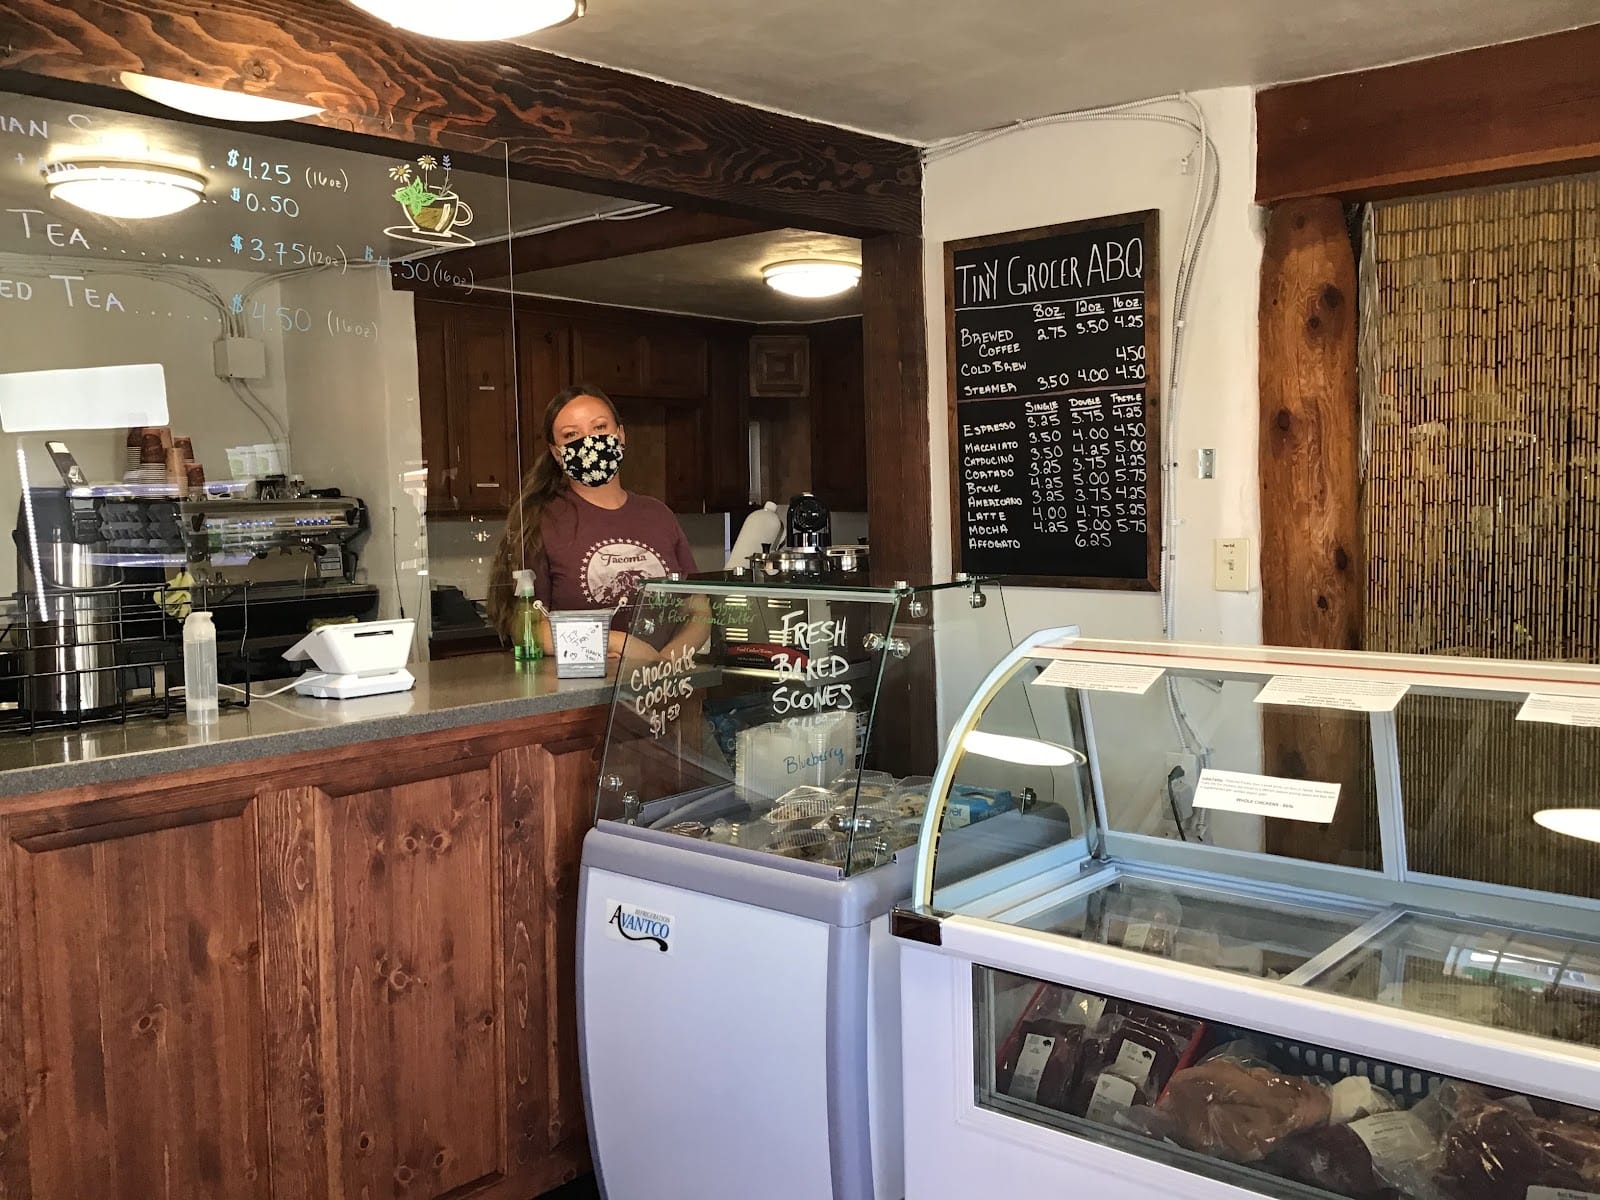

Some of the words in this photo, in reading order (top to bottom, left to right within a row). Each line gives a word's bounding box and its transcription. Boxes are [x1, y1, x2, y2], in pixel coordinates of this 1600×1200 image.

[226, 148, 292, 185] $4.25
[229, 186, 300, 219] $0.50
[6, 208, 91, 250] TEA
[955, 259, 998, 305] TINY
[1007, 255, 1083, 296] GROCER
[1086, 237, 1144, 287] ABQ
[48, 274, 125, 313] TEA
[231, 294, 312, 333] $4.50
[960, 328, 1014, 348] BREWED
[1037, 326, 1068, 341] 2.75
[1076, 318, 1109, 335] 3.50
[1114, 315, 1144, 329] 4.25
[960, 363, 992, 377] COLD
[992, 361, 1027, 373] BREW
[1115, 346, 1146, 362] 4.50
[978, 343, 1021, 358] COFFEE
[964, 382, 1018, 396] STEAMER
[1037, 373, 1070, 391] 3.50
[1077, 367, 1109, 382] 4.00
[1115, 364, 1146, 380] 4.50
[1025, 401, 1059, 413] SINGLE
[1068, 396, 1101, 408] DOUBLE
[963, 421, 1016, 437] ESPRESSO
[1028, 414, 1061, 429] 3.25
[1071, 409, 1105, 424] 3.75
[1112, 406, 1143, 419] 4.25
[964, 441, 1019, 454] MACCHIATO
[1028, 430, 1062, 444] 3.50
[1072, 428, 1109, 440] 4.00
[1114, 422, 1146, 437] 4.50
[964, 454, 1015, 467] CAPPUCINO
[1031, 445, 1064, 461] 3.50
[1072, 443, 1110, 456] 4.25
[1114, 440, 1146, 453] 5.00
[964, 469, 1015, 480] CORTADO
[1028, 459, 1062, 477] 3.25
[1072, 456, 1107, 472] 3.75
[1115, 454, 1146, 466] 4.25
[966, 482, 1002, 496] Breve
[1030, 476, 1064, 489] 4.25
[1072, 473, 1110, 486] 5.00
[1114, 469, 1147, 482] 5.75
[967, 511, 1007, 522] LATTE
[1032, 506, 1068, 521] 4.00
[1076, 504, 1112, 517] 4.75
[1115, 503, 1146, 516] 5.25
[968, 497, 1023, 508] AMERICANO
[1032, 490, 1065, 505] 3.25
[1074, 488, 1112, 502] 3.75
[1115, 486, 1147, 499] 4.25
[968, 525, 1009, 536] MOCHA
[1033, 520, 1069, 534] 4.25
[1077, 519, 1112, 532] 5.00
[1117, 519, 1147, 533] 5.75
[968, 538, 1021, 550] AFFOGATO
[1075, 533, 1112, 548] 6.25
[598, 551, 648, 567] Tacoma
[780, 609, 847, 651] FRESH
[770, 652, 850, 685] BAKED
[771, 683, 853, 714] SCONES
[783, 745, 845, 775] Blueberry
[608, 904, 670, 942] AVANTCO
